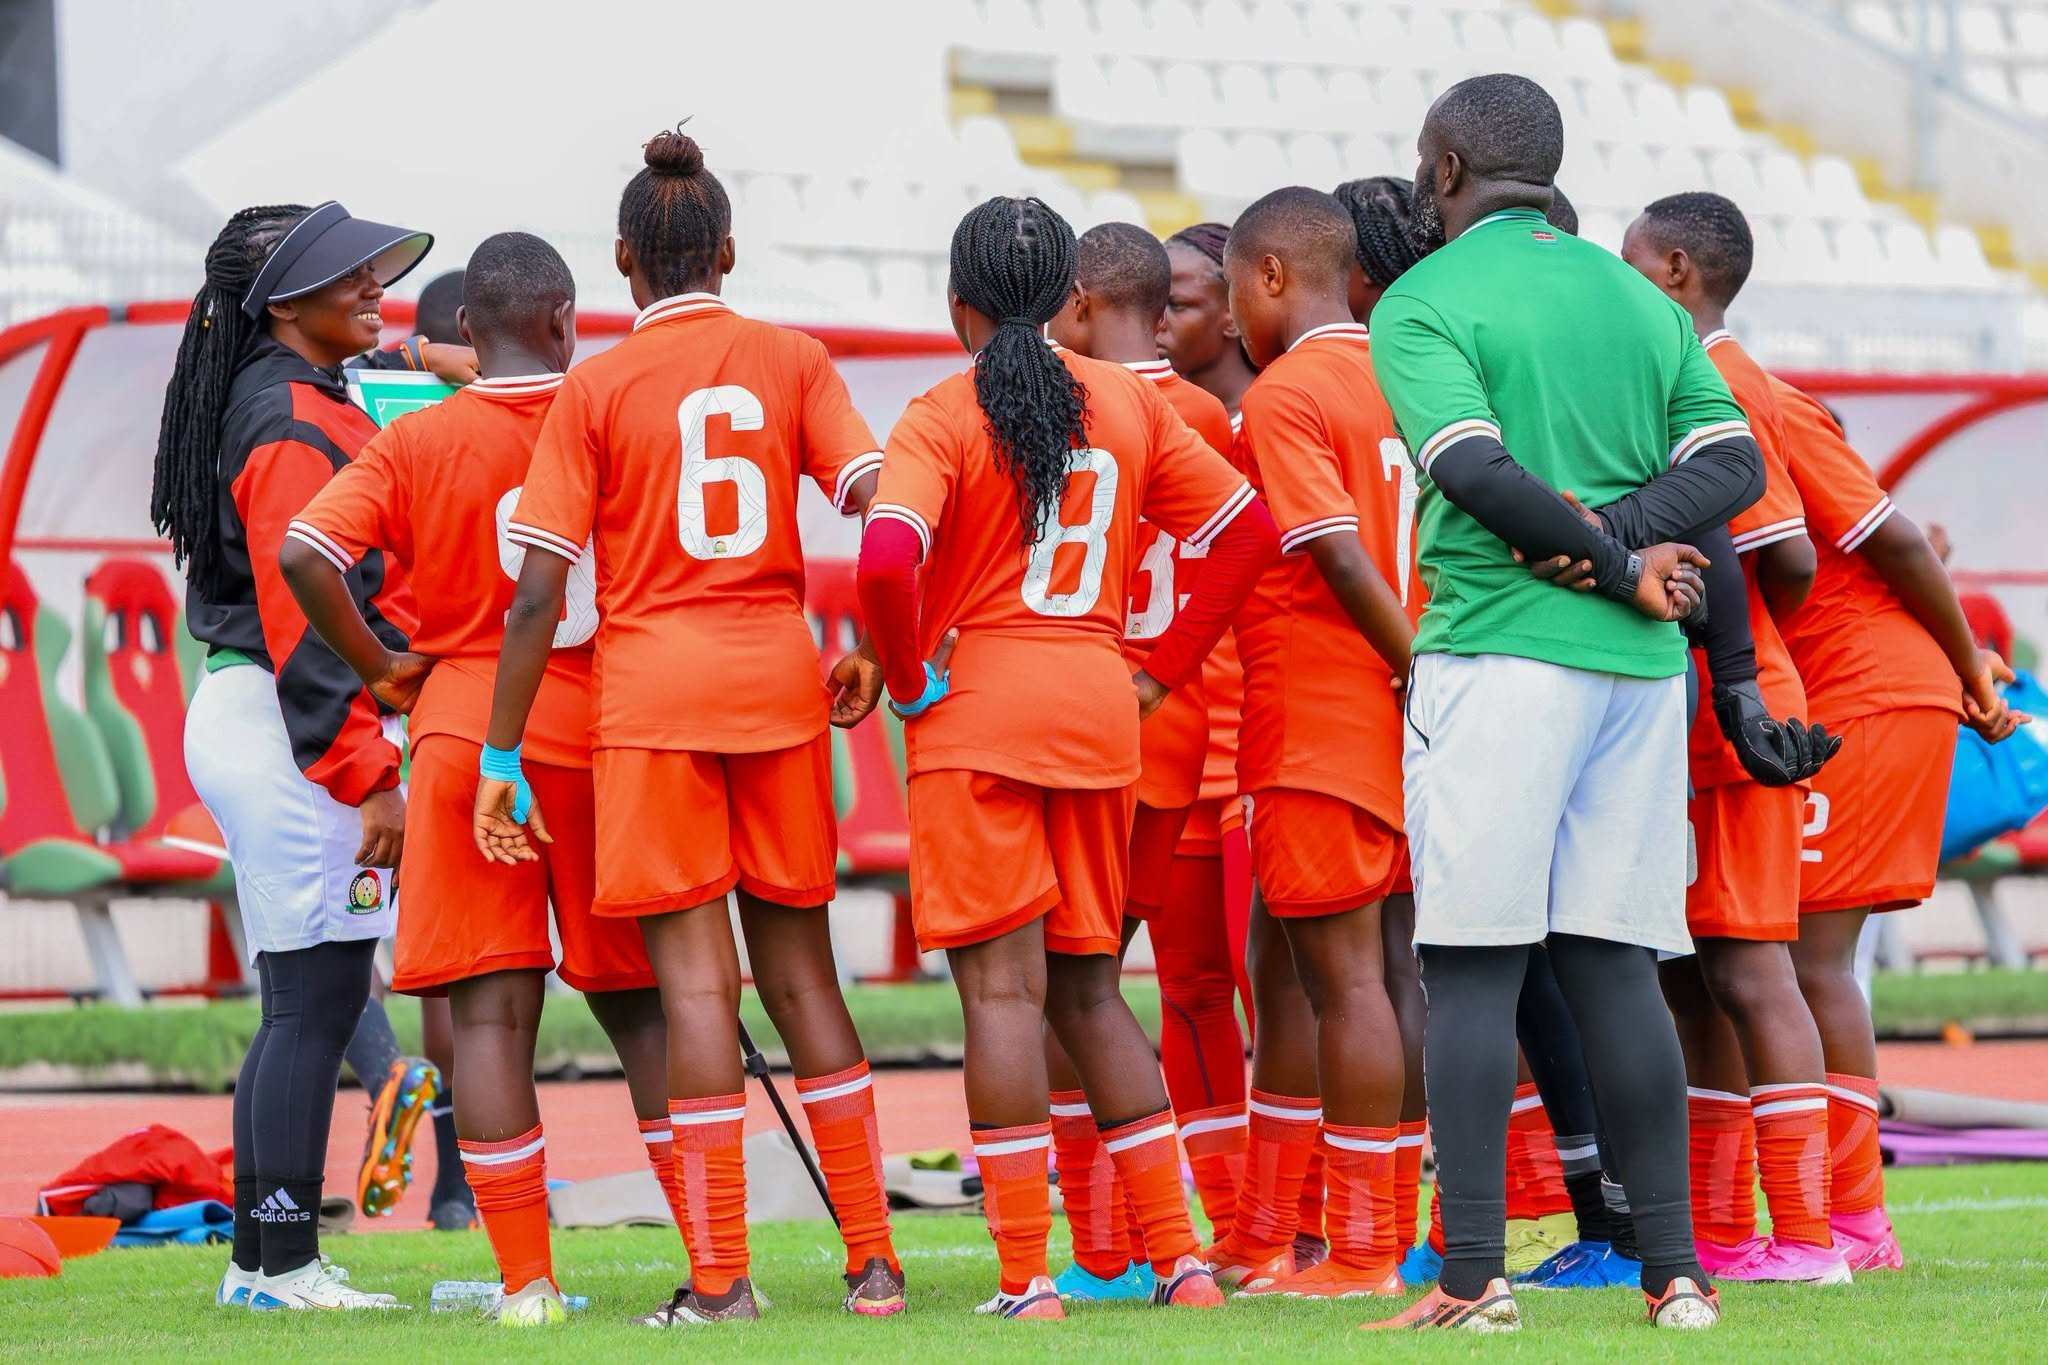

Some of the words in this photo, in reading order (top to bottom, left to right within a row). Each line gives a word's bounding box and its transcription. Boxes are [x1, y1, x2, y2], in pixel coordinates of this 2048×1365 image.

[677, 385, 768, 560] 6
[1021, 448, 1119, 617] 8
[259, 1209, 311, 1222] adidas
